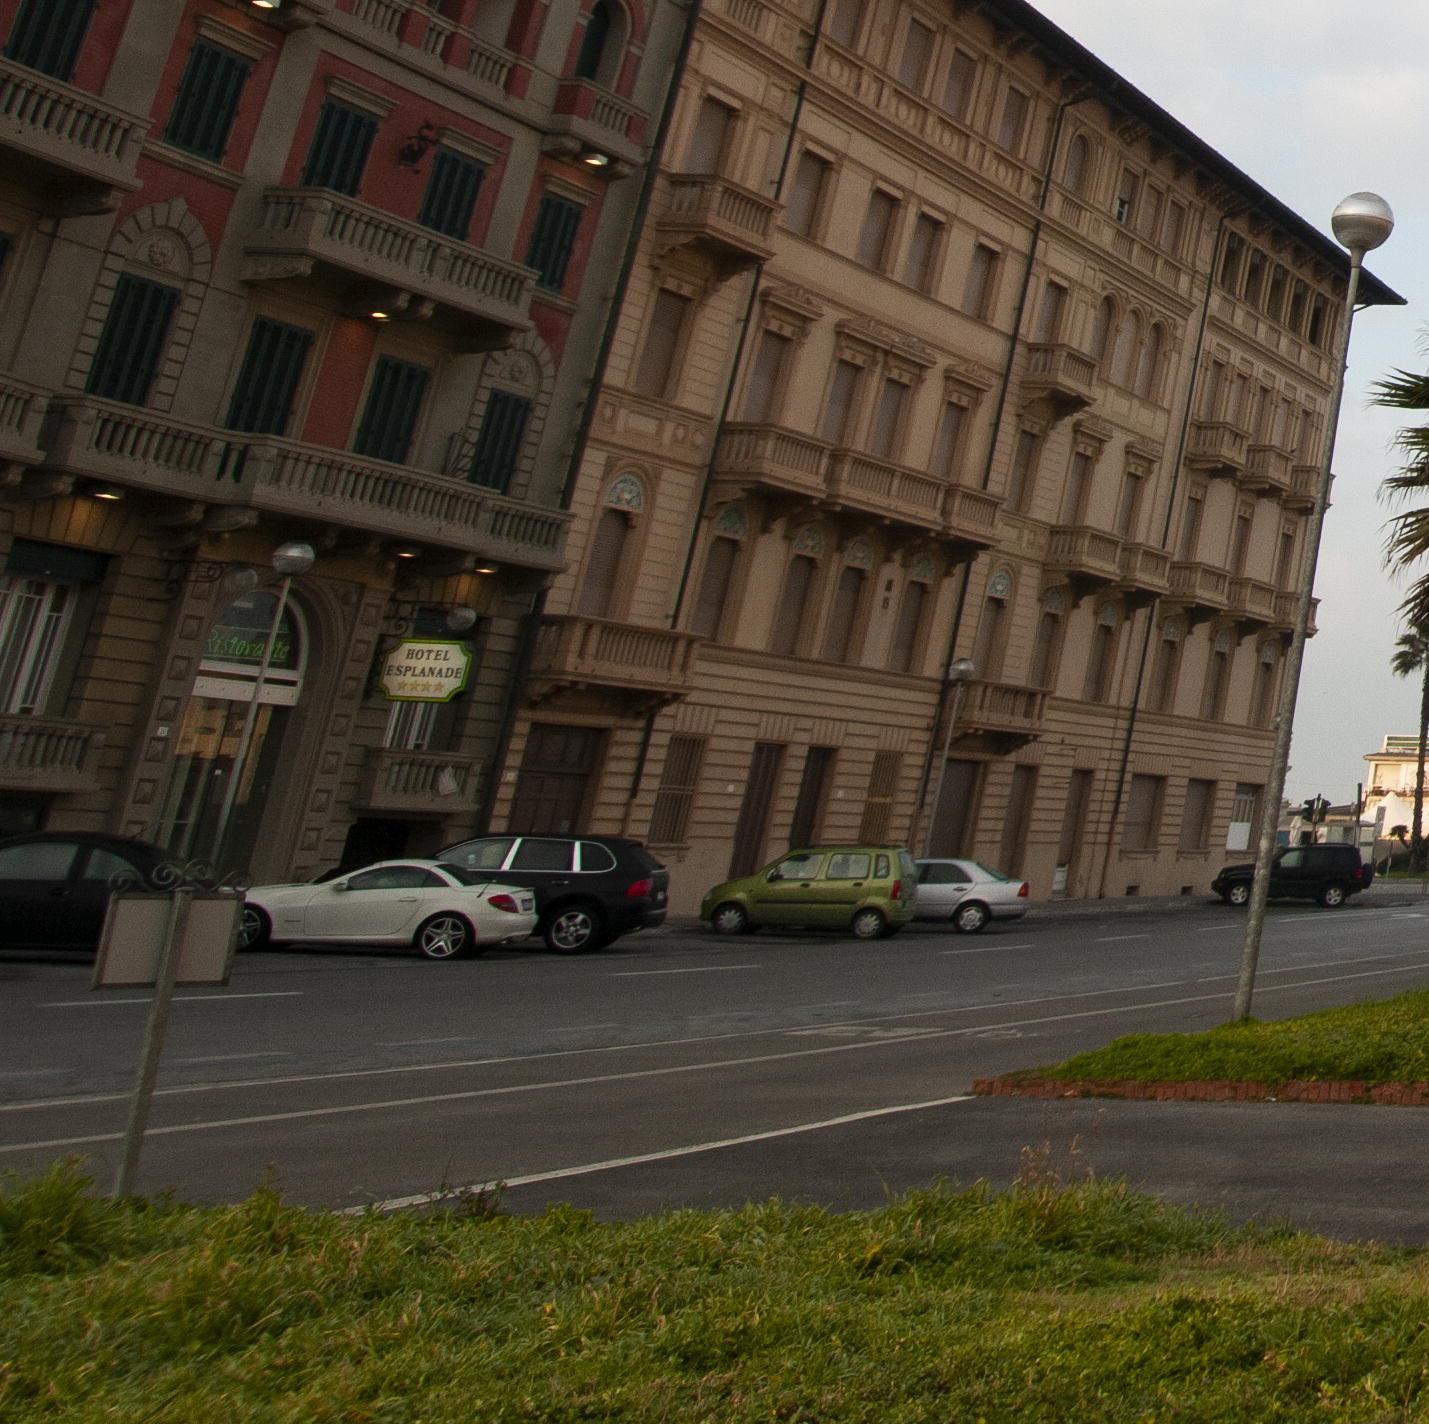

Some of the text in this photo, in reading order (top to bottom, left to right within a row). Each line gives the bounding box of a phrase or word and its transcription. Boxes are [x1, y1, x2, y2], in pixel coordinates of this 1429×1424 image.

[205, 629, 290, 659] Ristorate
[405, 648, 451, 661] HOTEL
[385, 664, 463, 679] ESPLANADE
